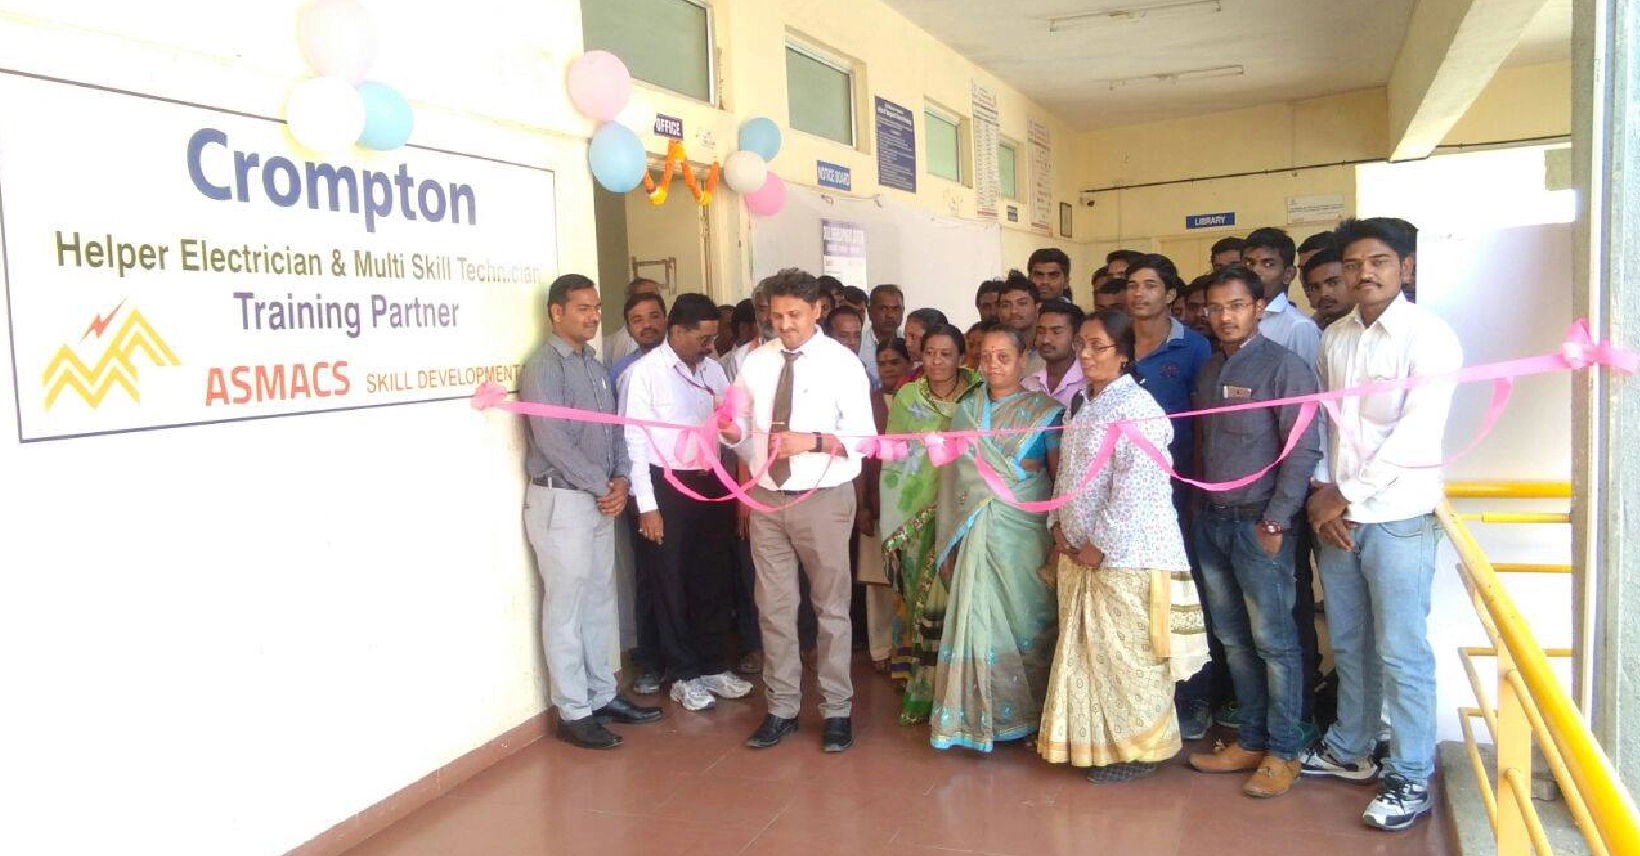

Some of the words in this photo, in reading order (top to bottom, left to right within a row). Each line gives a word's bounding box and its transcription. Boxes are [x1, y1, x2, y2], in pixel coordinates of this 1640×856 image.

[655, 117, 681, 137] OFFICE
[187, 127, 477, 233] Crompton
[1194, 215, 1226, 226] LIBRARY
[55, 230, 169, 277] Helper
[180, 238, 322, 276] Electrician
[331, 248, 347, 277] &
[354, 248, 405, 279] Multi
[411, 253, 451, 281] Skill
[233, 291, 361, 338] Training
[371, 293, 459, 329] Partner
[205, 360, 351, 407] ASMACS
[366, 371, 413, 393] SKILL
[417, 364, 521, 389] DEVELOPMENT
